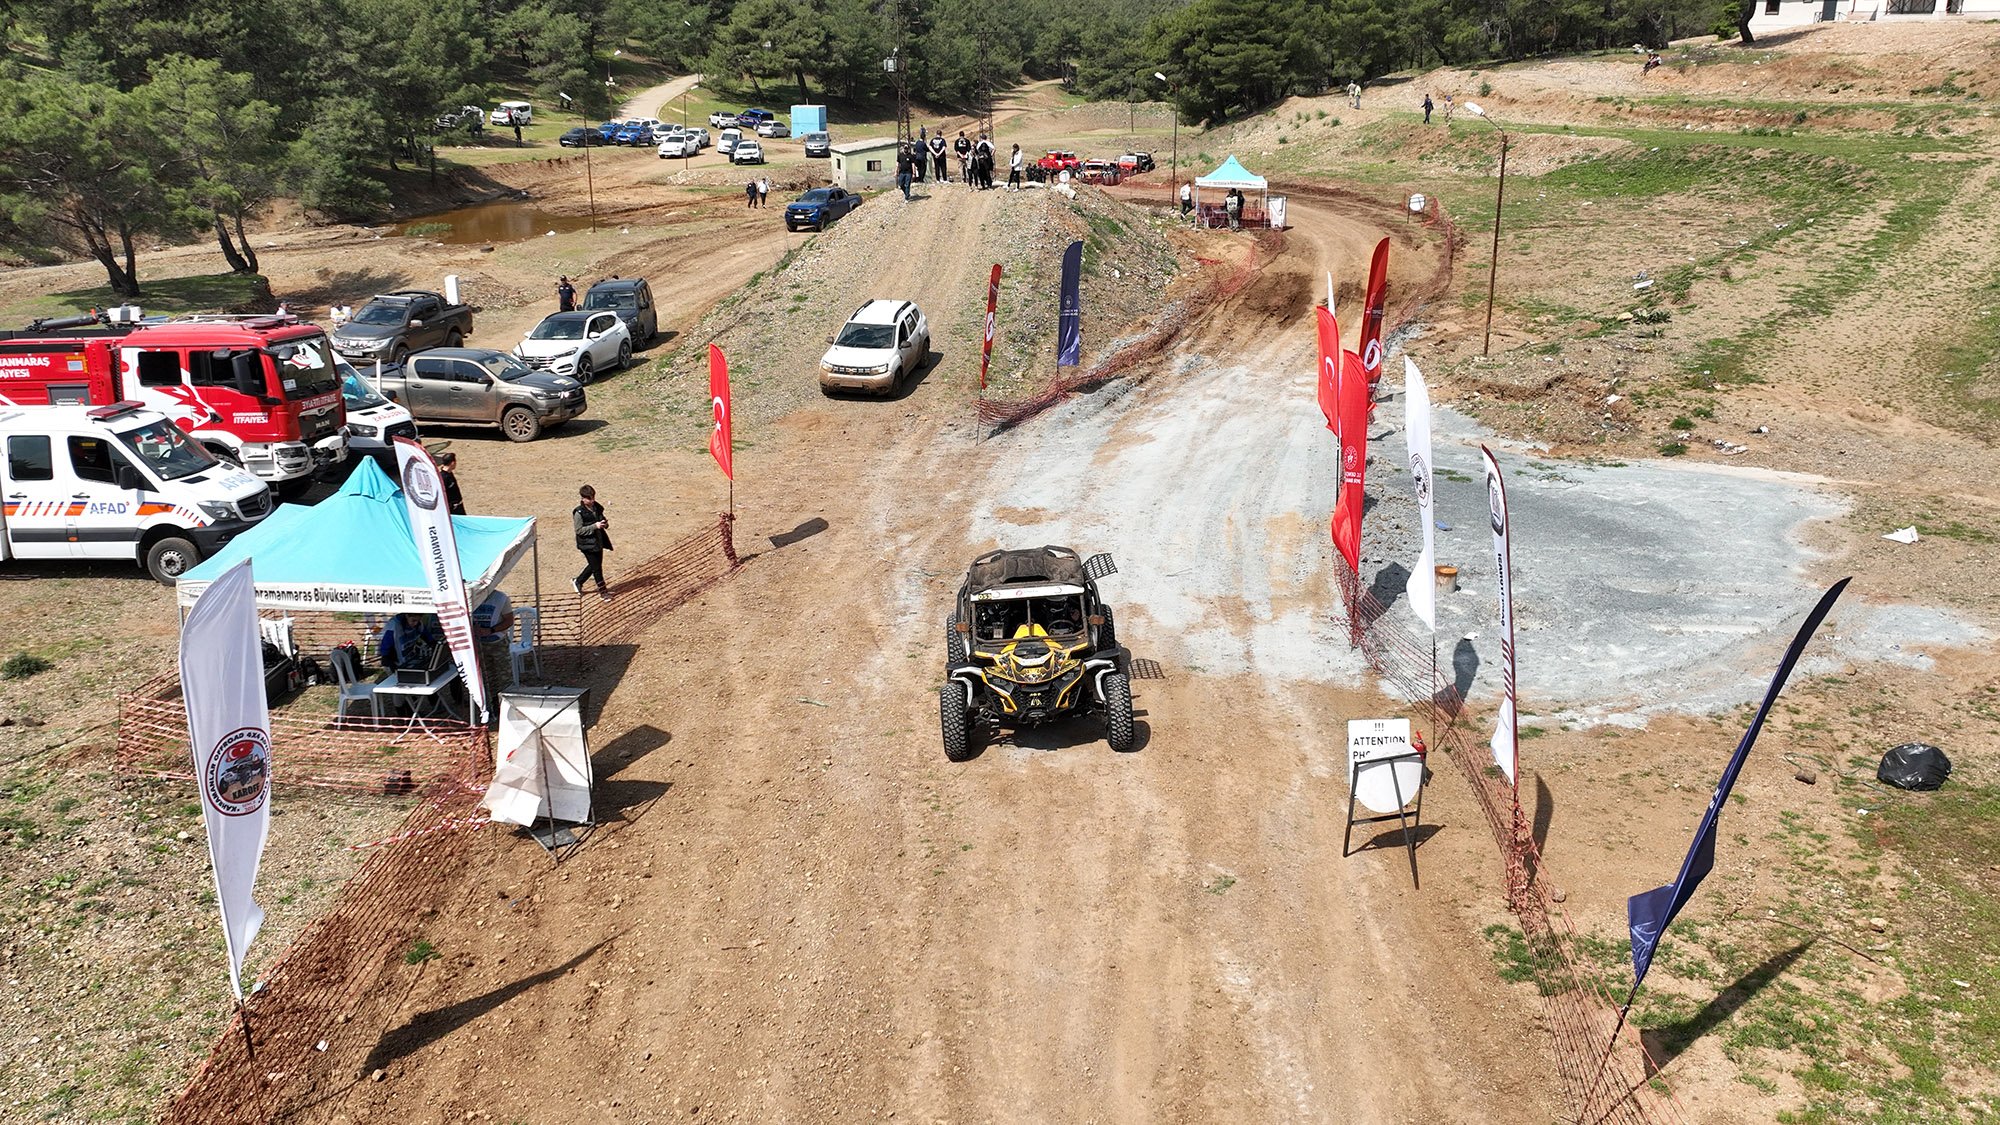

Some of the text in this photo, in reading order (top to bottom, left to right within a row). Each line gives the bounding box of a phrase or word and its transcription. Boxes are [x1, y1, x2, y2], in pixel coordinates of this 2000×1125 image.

[0, 357, 50, 367] ANMARAŞ
[218, 472, 254, 491] AFAD
[90, 503, 126, 514] AFAD
[362, 589, 405, 606] Belediyesi
[214, 732, 244, 761] OFFROAD
[1353, 736, 1406, 746] ATTENTION
